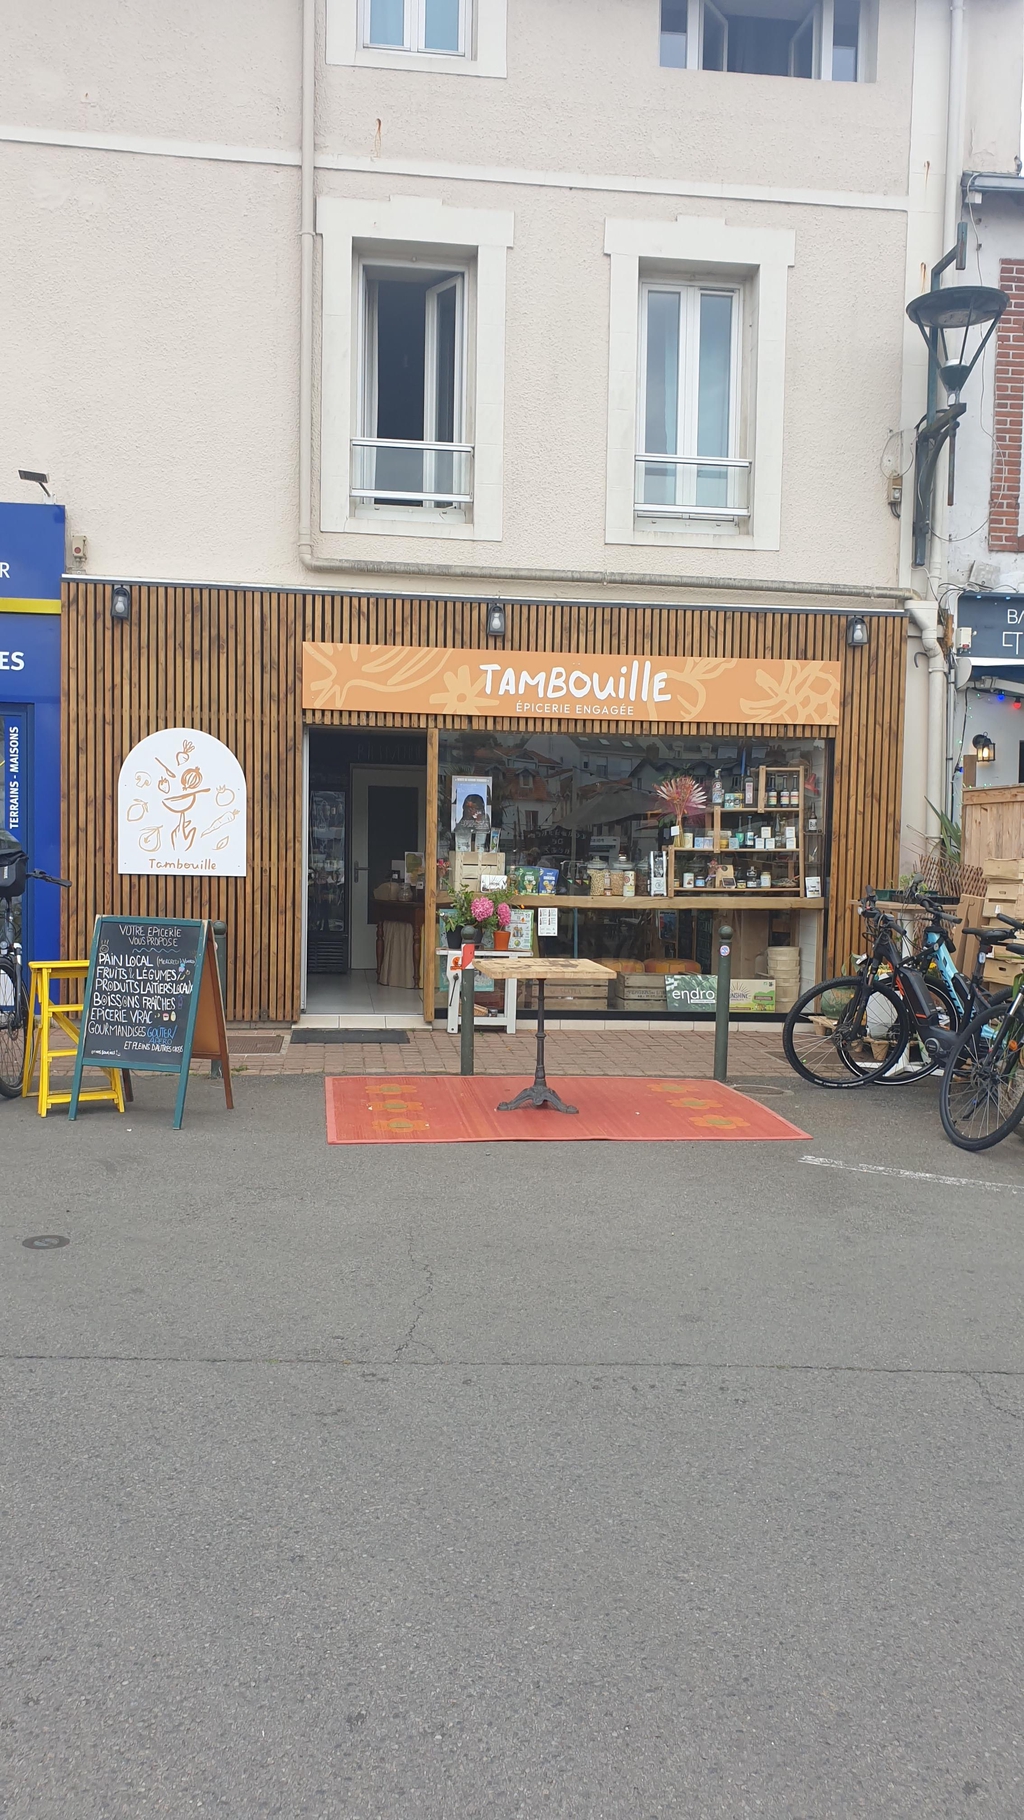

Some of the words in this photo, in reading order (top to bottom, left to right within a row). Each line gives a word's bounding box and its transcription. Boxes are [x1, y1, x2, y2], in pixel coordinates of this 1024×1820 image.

[516, 700, 570, 714] ÉPICERIE
[576, 703, 634, 716] ENGAGÉE
[9, 726, 19, 773] MAISONS
[9, 781, 19, 829] TERRAINS
[149, 858, 217, 870] Tambouille
[119, 925, 145, 936] VOTRE
[128, 936, 146, 945] VOUS
[147, 937, 178, 947] PROPOSE
[125, 954, 153, 967] LOCAL
[136, 967, 177, 981] LÉGUMES
[672, 987, 715, 1004] endro
[130, 1009, 153, 1024] VRAC
